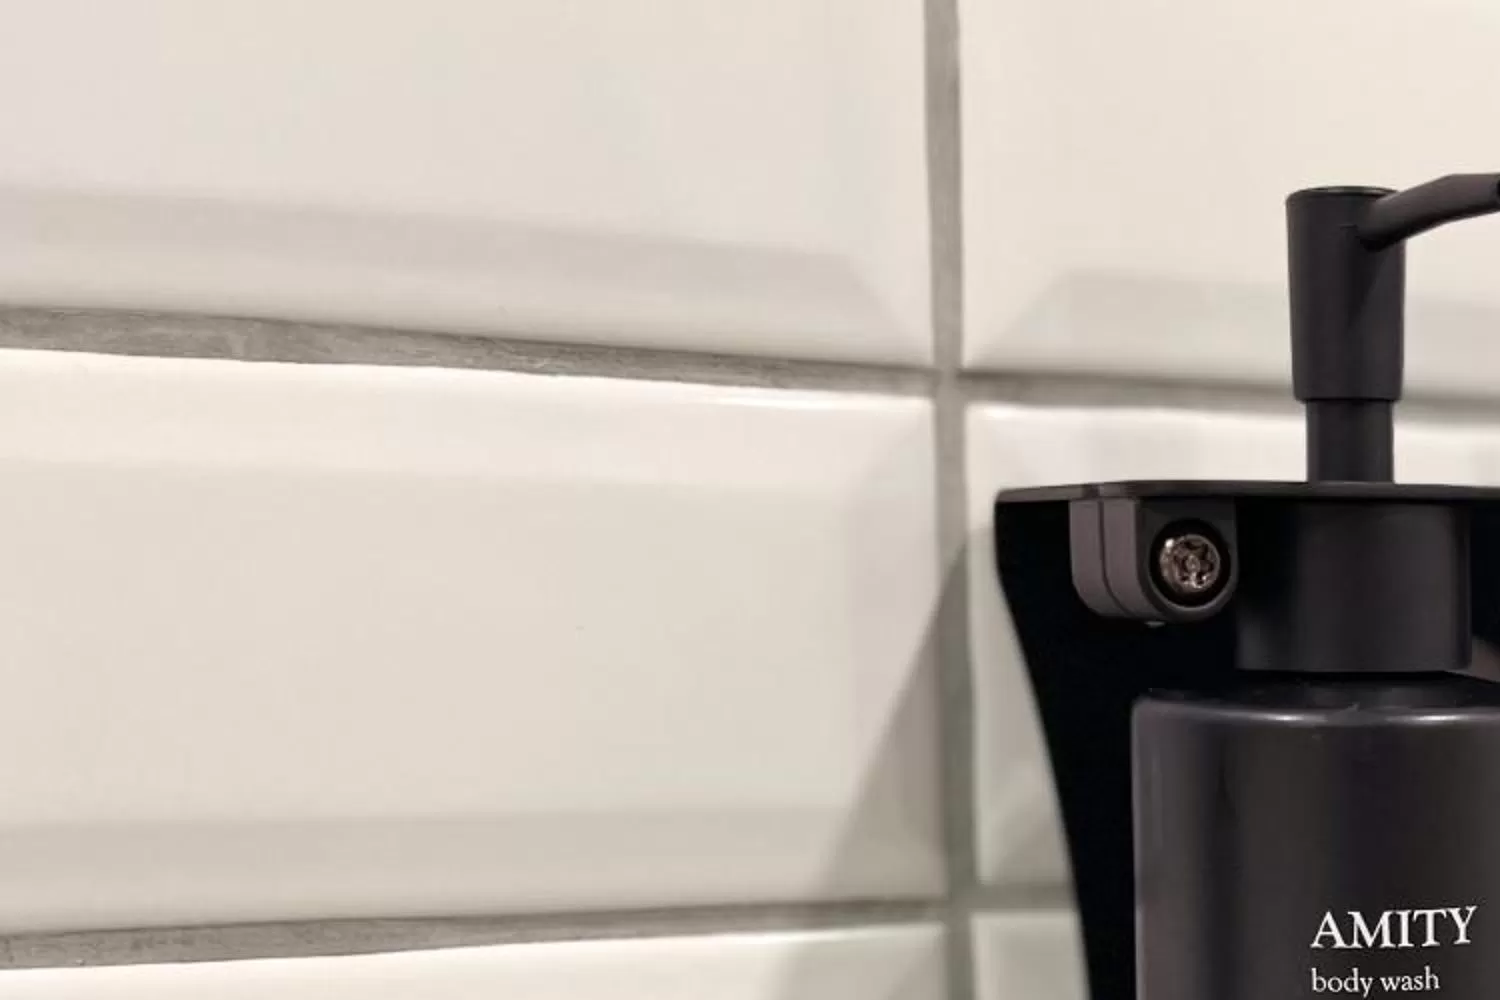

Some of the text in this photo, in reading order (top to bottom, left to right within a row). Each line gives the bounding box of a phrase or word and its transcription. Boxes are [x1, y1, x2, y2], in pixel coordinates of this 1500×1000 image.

[1310, 906, 1478, 948] AMITY
[1311, 966, 1440, 998] body wash
